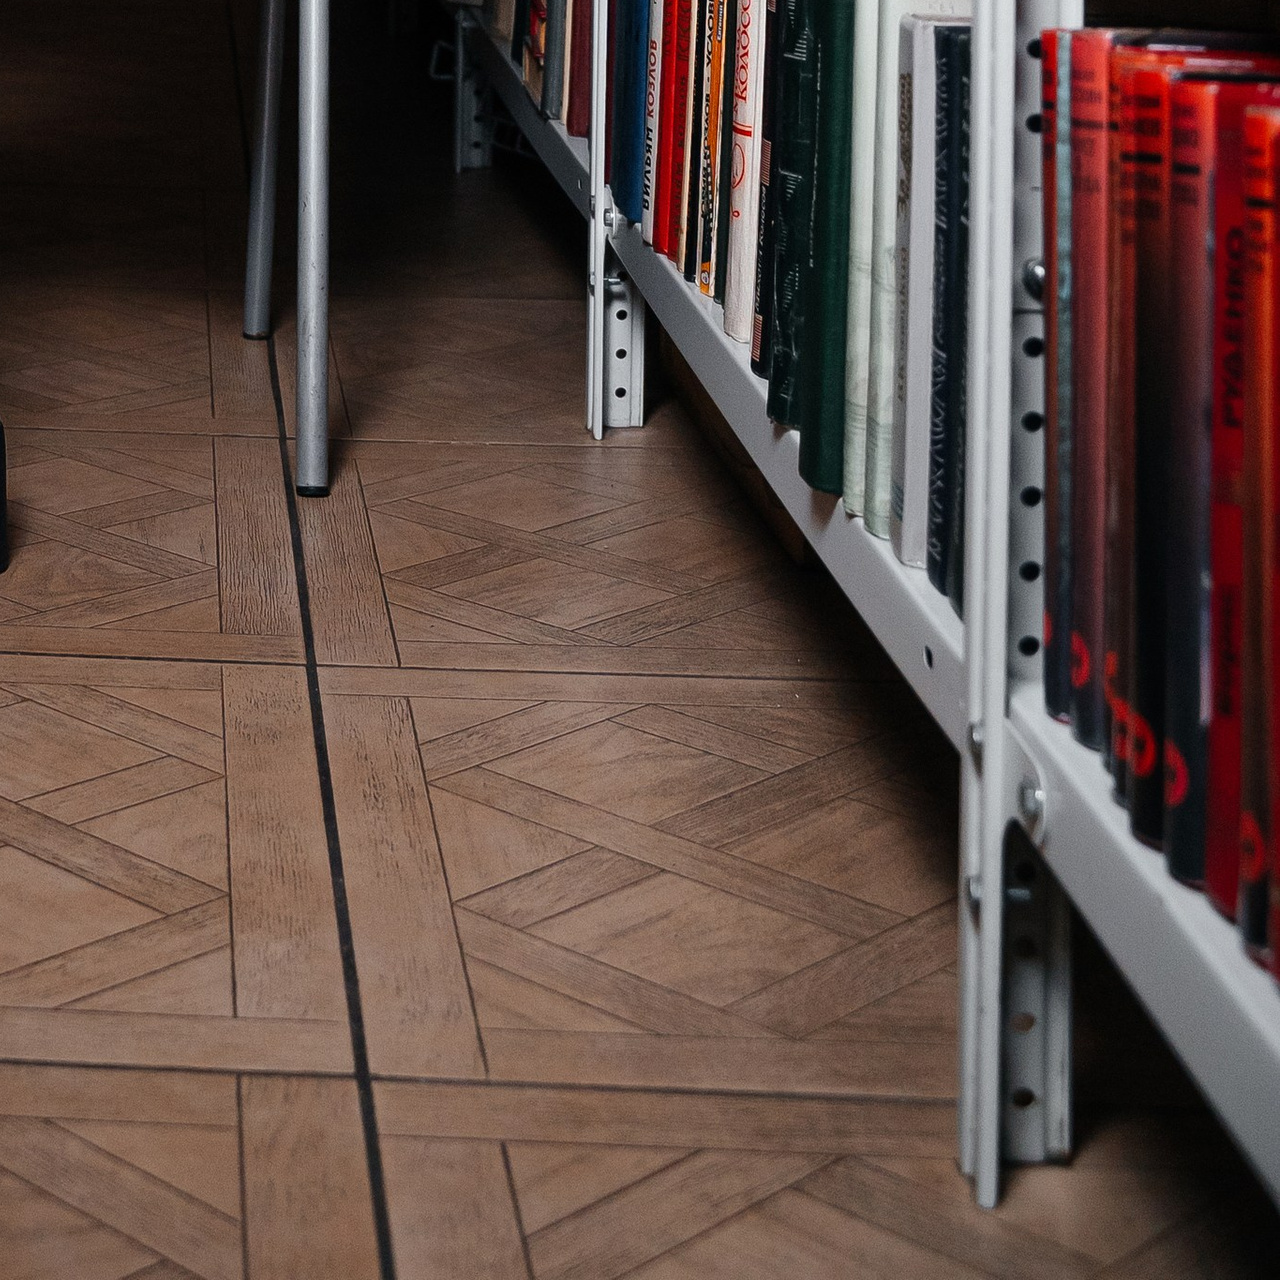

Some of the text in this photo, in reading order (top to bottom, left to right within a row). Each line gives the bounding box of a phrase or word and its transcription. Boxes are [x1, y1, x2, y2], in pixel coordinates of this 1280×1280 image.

[647, 39, 658, 120] КОЗЛОВ
[703, 93, 711, 160] КОЗЛОВ
[643, 127, 653, 210] ВИЛЬЯМ
